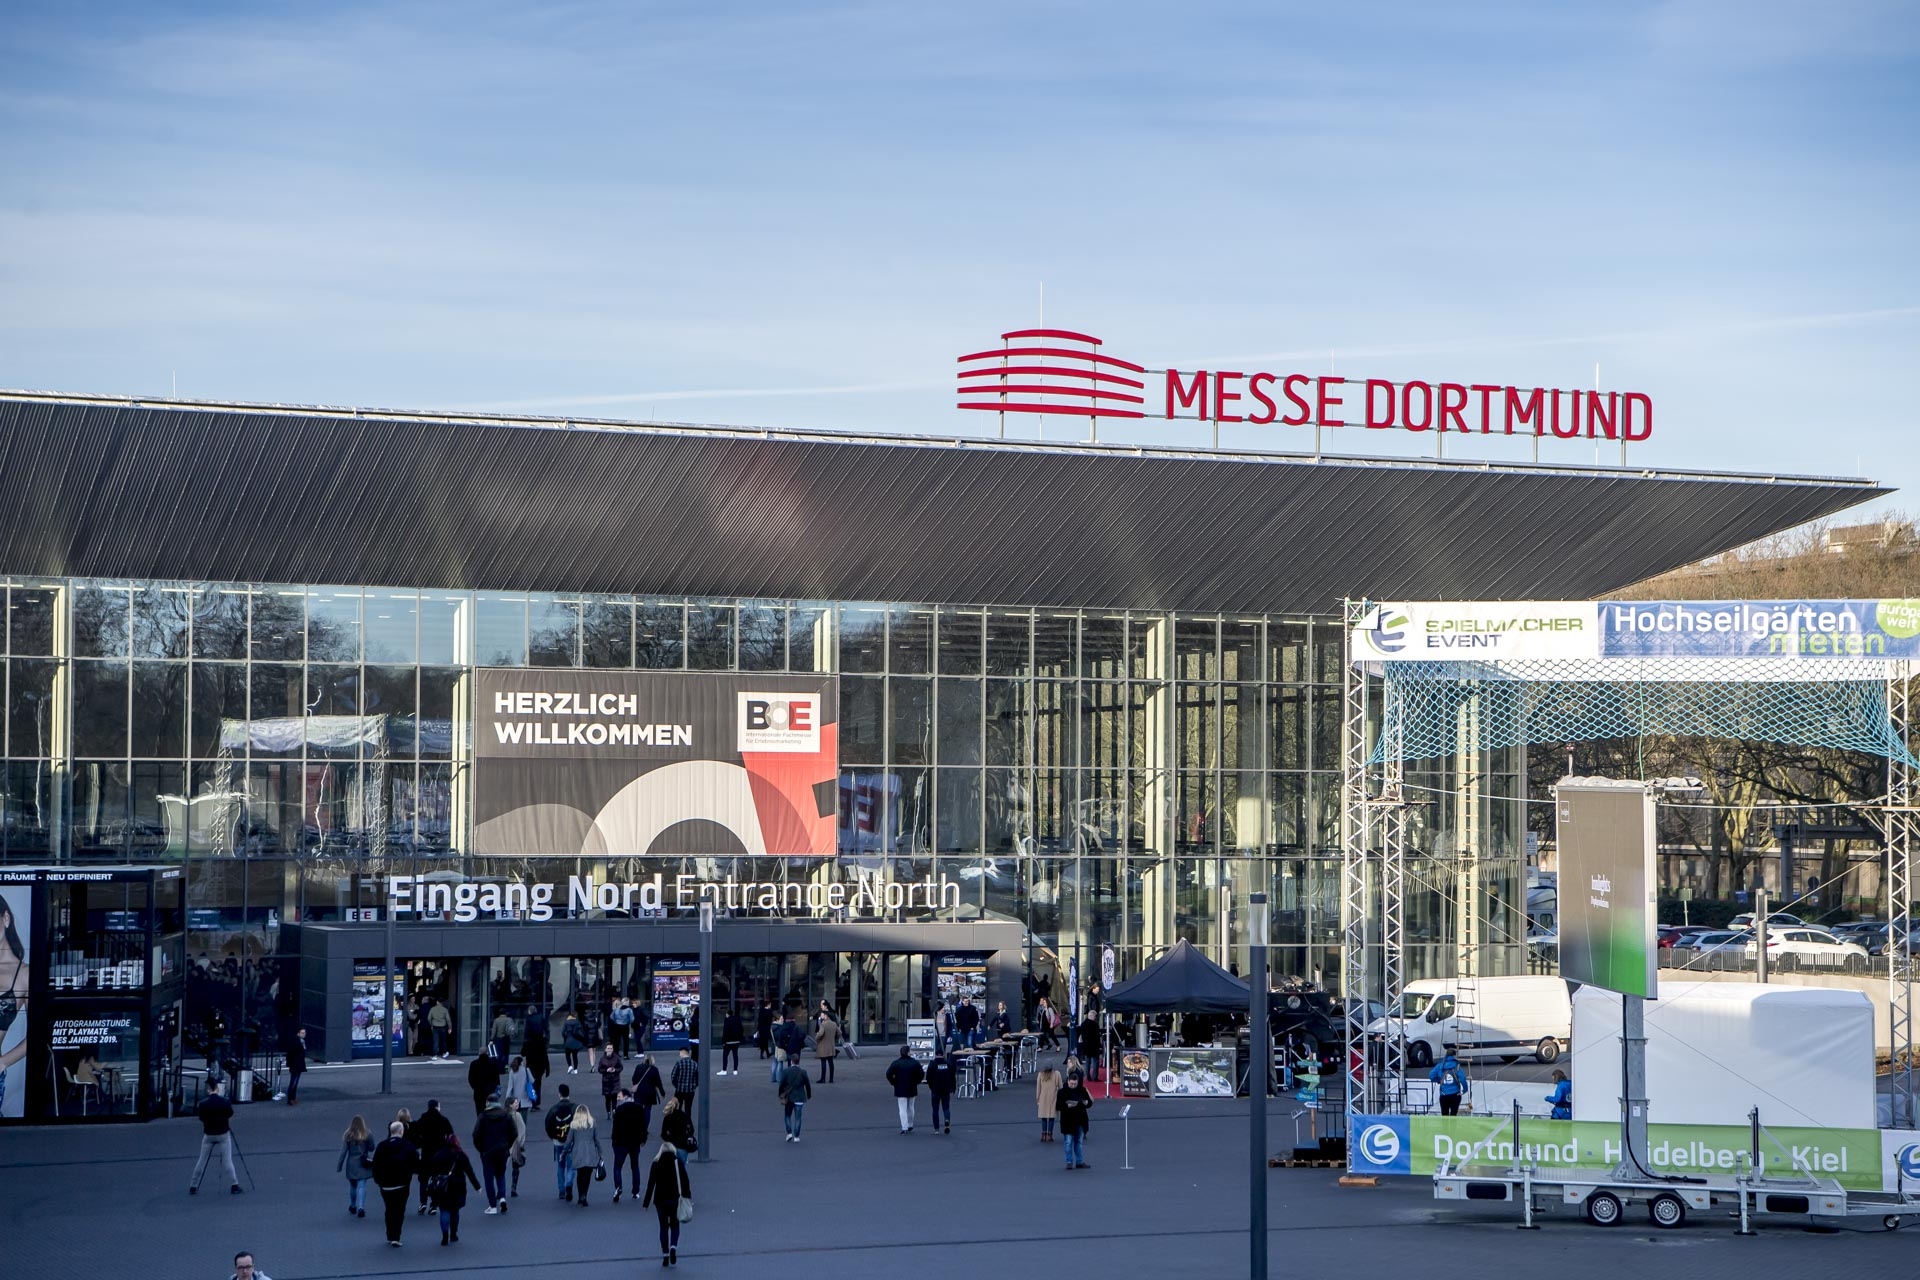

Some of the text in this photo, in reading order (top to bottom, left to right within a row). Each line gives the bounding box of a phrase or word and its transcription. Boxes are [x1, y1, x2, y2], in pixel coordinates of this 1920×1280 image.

[1164, 368, 1653, 441] MESSE DORTMUND
[1425, 617, 1584, 633] SPIELMACHER
[1614, 604, 1857, 640] Hochseilgärten
[1426, 634, 1502, 648] EVENT
[1769, 627, 1885, 655] mieten
[494, 691, 638, 715] HERZLICH
[746, 700, 812, 731] BOE
[493, 722, 693, 746] WILLKOMMEN
[4, 872, 37, 881] RÄUME
[46, 873, 113, 881] NEU DEFINIERT
[389, 872, 961, 922] Eingang Nord Entrance North
[52, 1028, 109, 1036] MIT PLAYMATE
[53, 1019, 131, 1028] AUTOGRAMMSTUNDE
[68, 1036, 98, 1044] JAHRES
[99, 1036, 118, 1044] 2019.
[1434, 1134, 1578, 1163] Dortmund
[1792, 1145, 1848, 1172] Kiel
